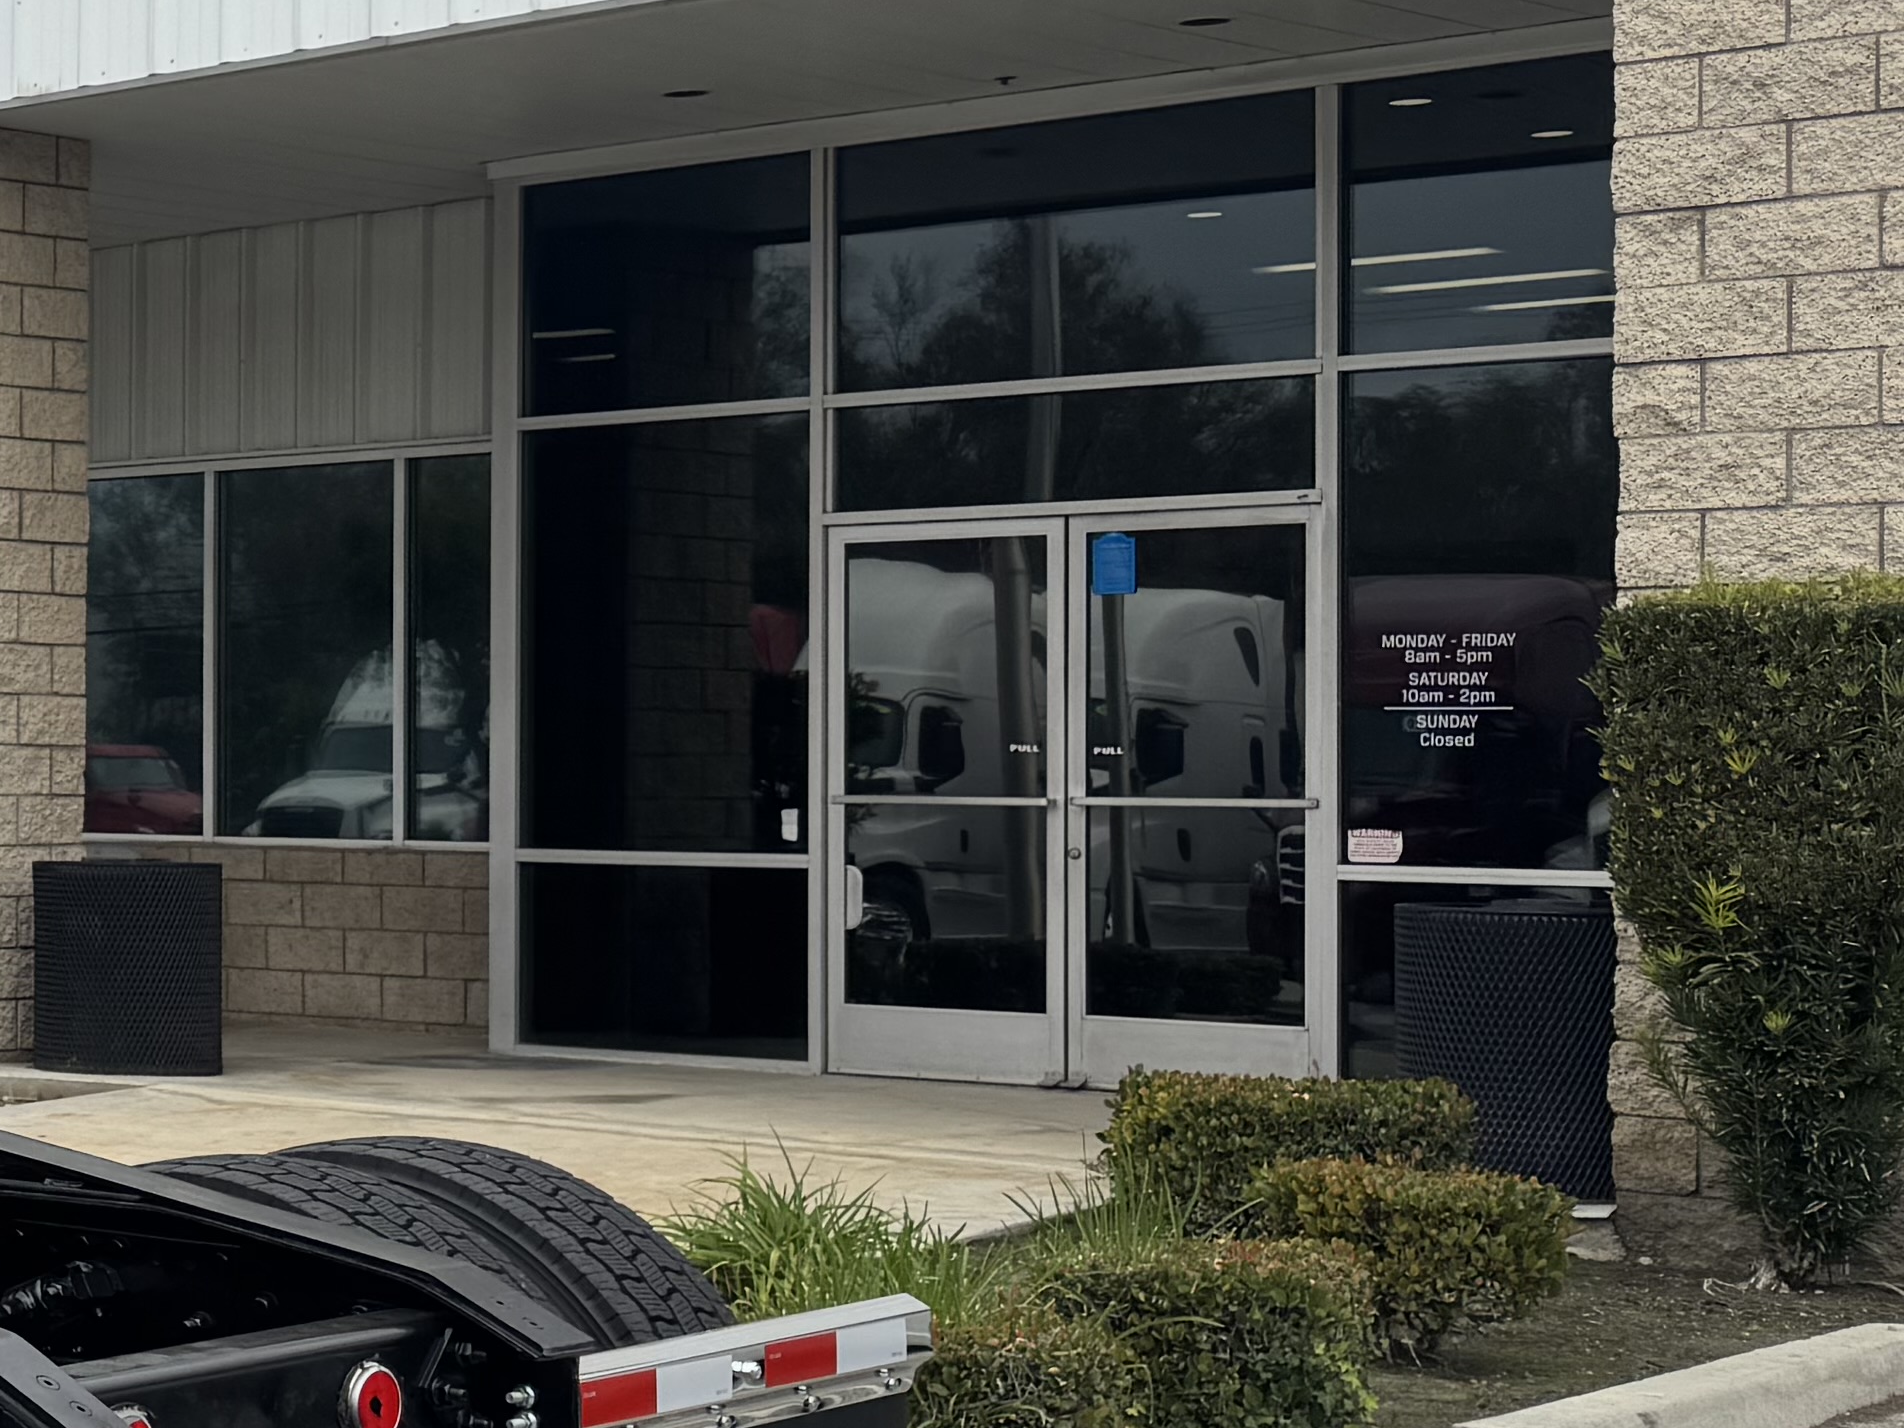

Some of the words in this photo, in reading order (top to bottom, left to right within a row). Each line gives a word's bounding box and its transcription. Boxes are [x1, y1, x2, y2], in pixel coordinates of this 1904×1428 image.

[1381, 633, 1446, 648] MONDAY
[1462, 632, 1516, 647] FRIDAY
[1404, 649, 1440, 663] 8am
[1456, 649, 1493, 665] 5pm
[1408, 671, 1489, 686] SATURDAY
[1401, 689, 1444, 703] 10am
[1459, 688, 1495, 705] 2pm
[1416, 714, 1479, 729] SUNDAY
[1420, 732, 1475, 747] Closed
[1009, 743, 1040, 753] PULL
[1093, 746, 1124, 755] PULL
